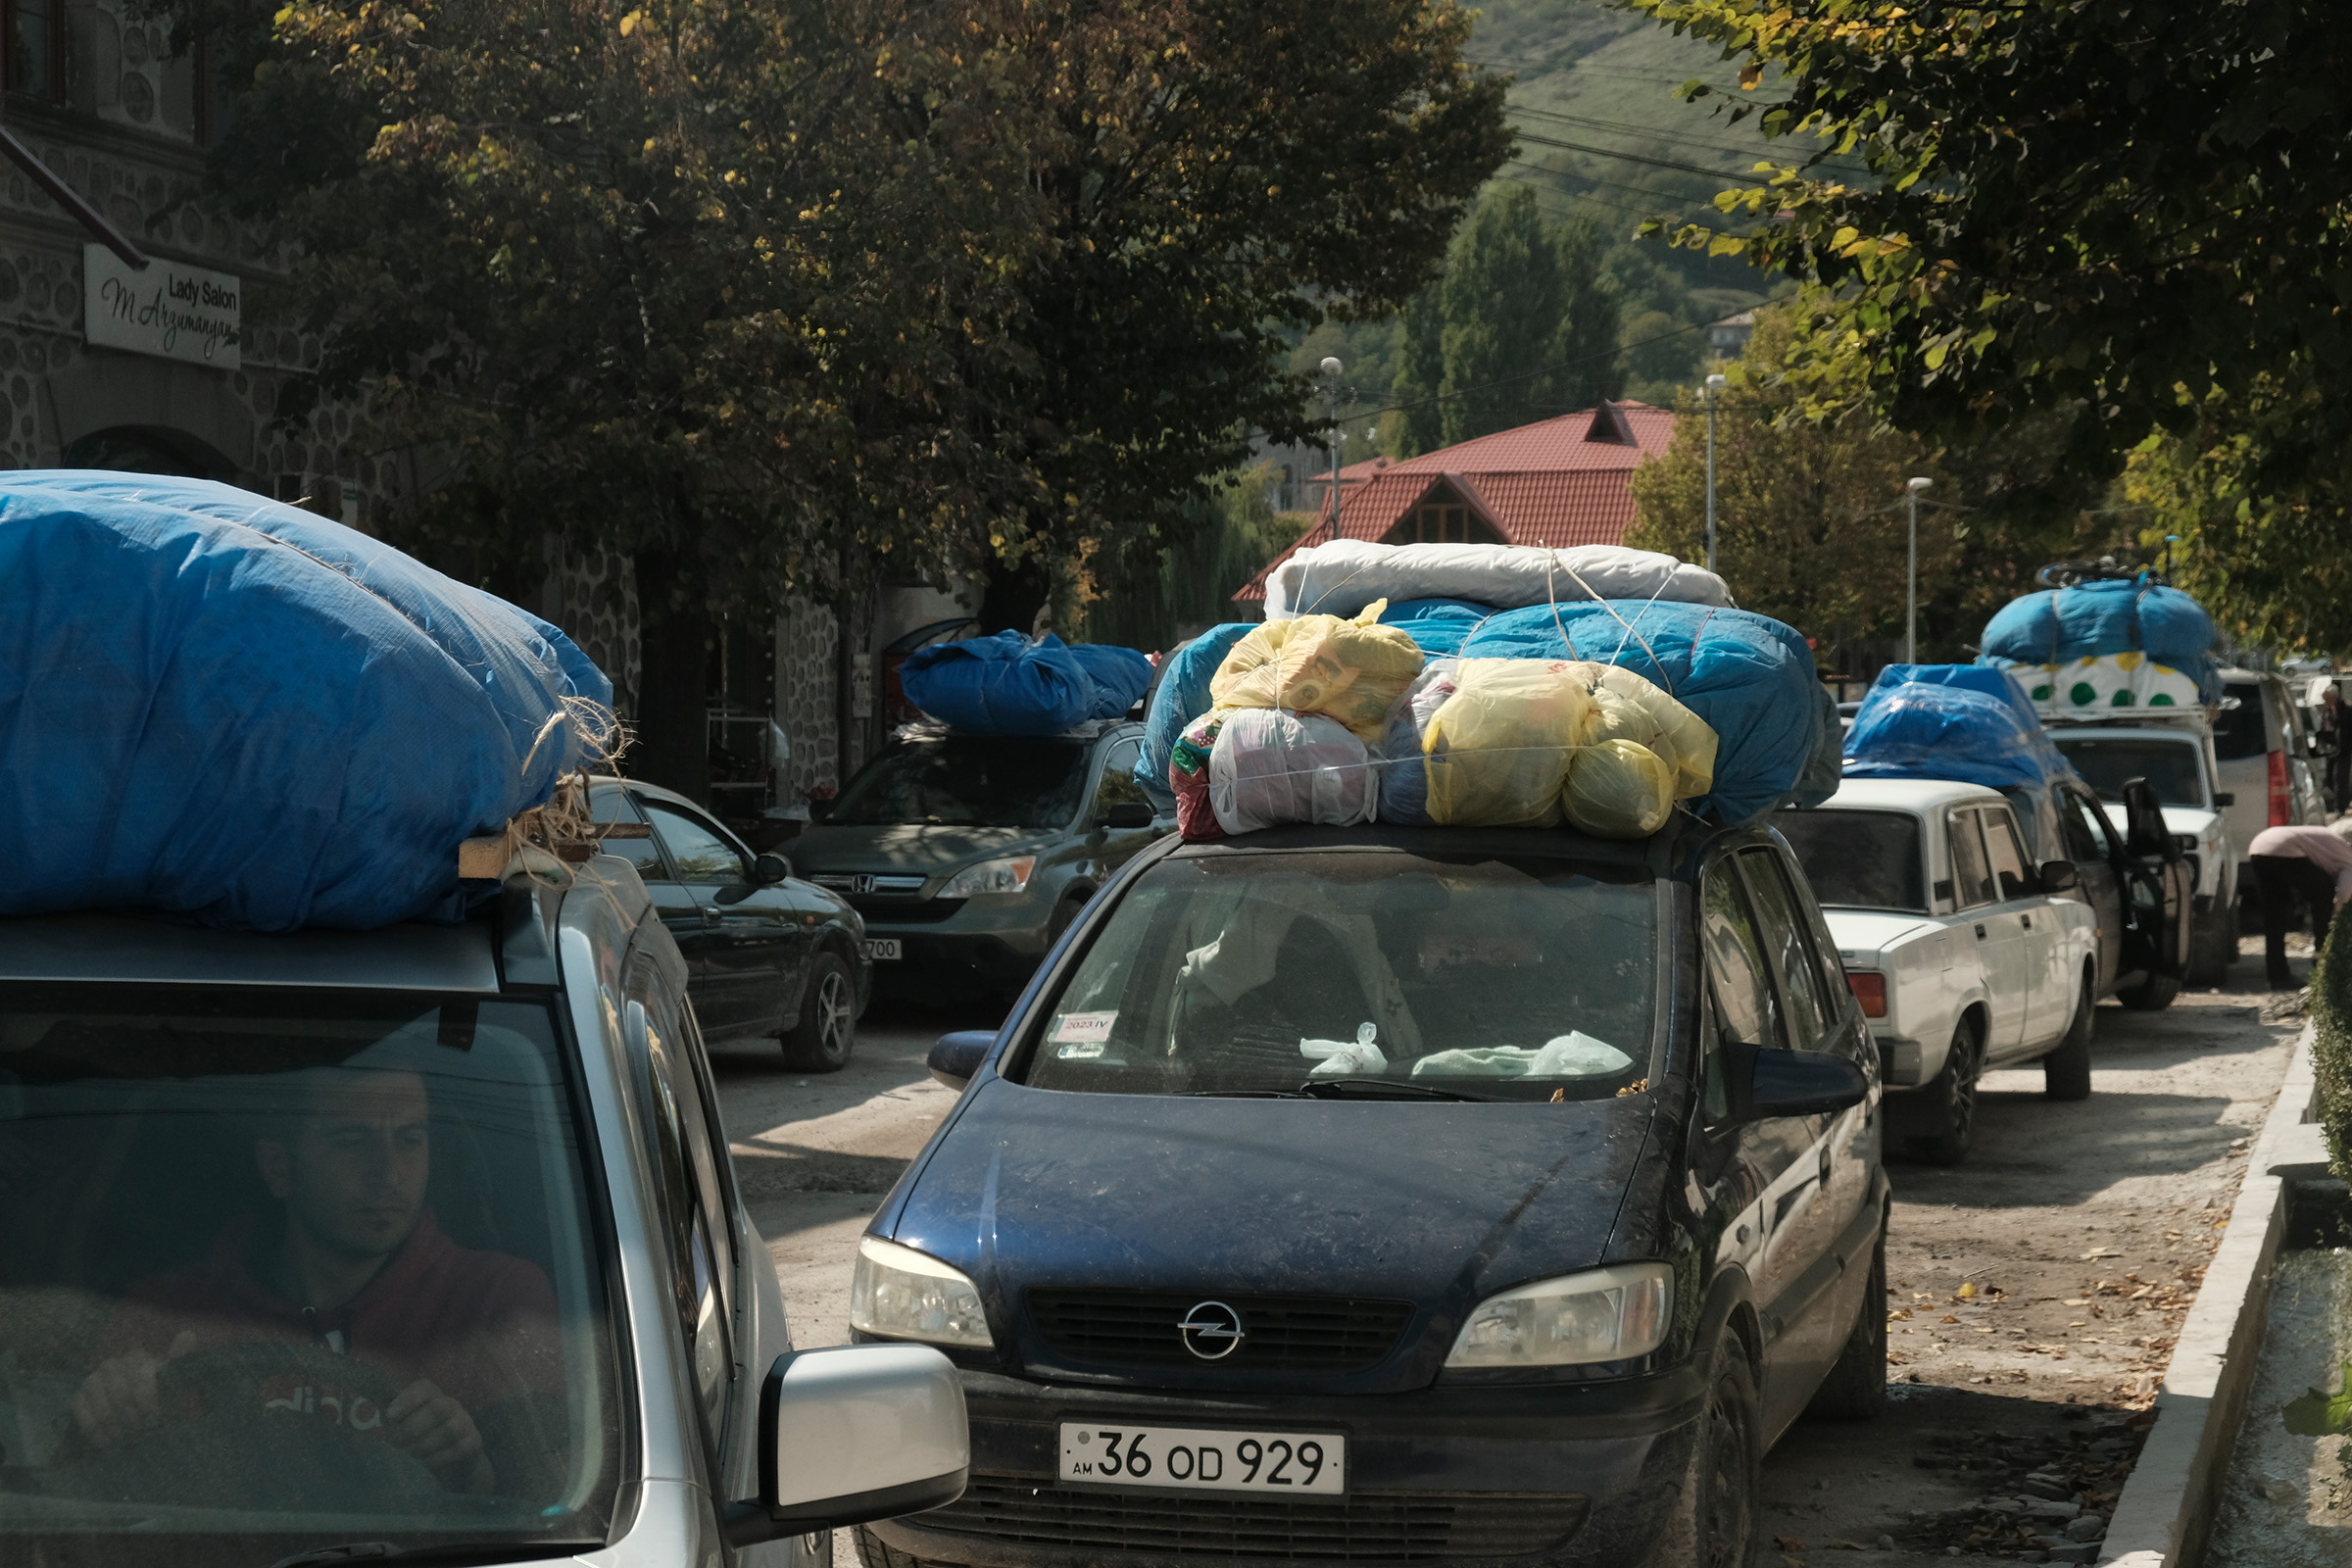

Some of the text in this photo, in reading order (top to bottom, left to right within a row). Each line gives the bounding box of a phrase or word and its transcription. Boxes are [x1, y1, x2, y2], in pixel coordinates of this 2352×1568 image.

[169, 271, 237, 312] Lady Salon
[867, 941, 895, 957] 700
[1065, 1020, 1094, 1030] 2023
[1072, 1431, 1324, 1486] AM 36 OD 929
